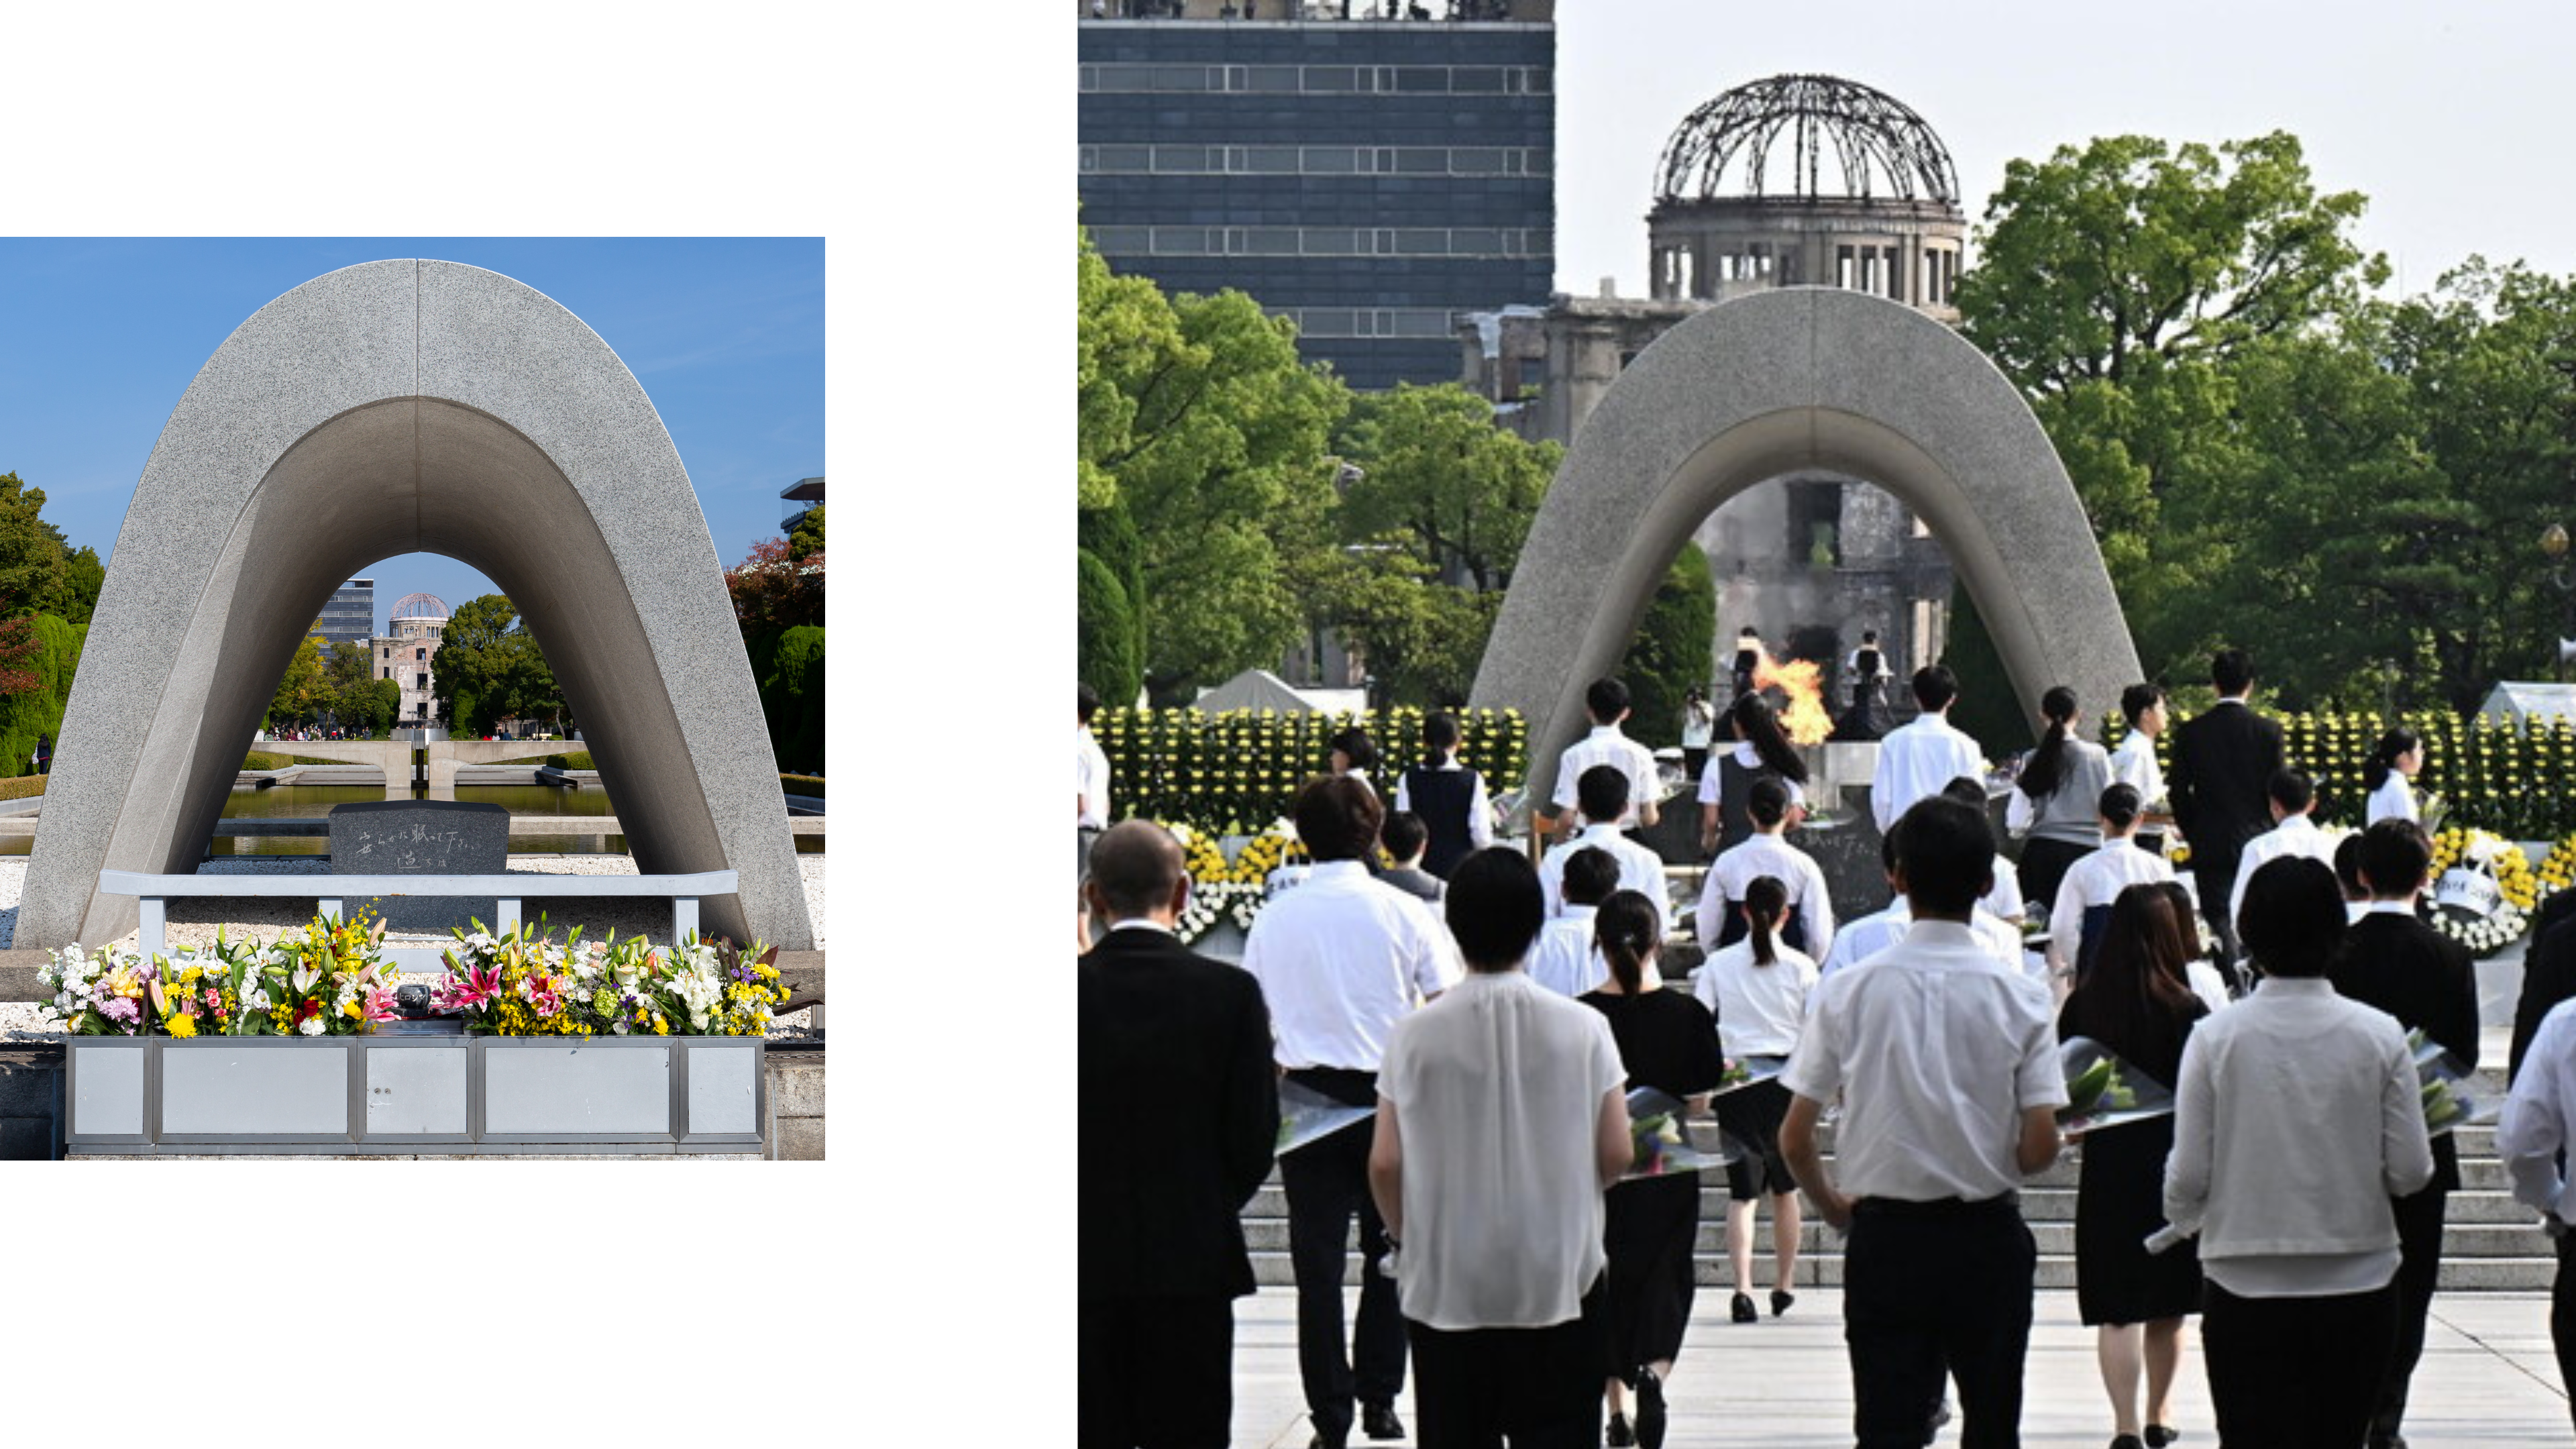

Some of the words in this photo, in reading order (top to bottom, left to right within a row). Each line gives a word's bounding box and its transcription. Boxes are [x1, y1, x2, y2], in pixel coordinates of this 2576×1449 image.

[356, 823, 474, 854] 安らかに眠って下さい
